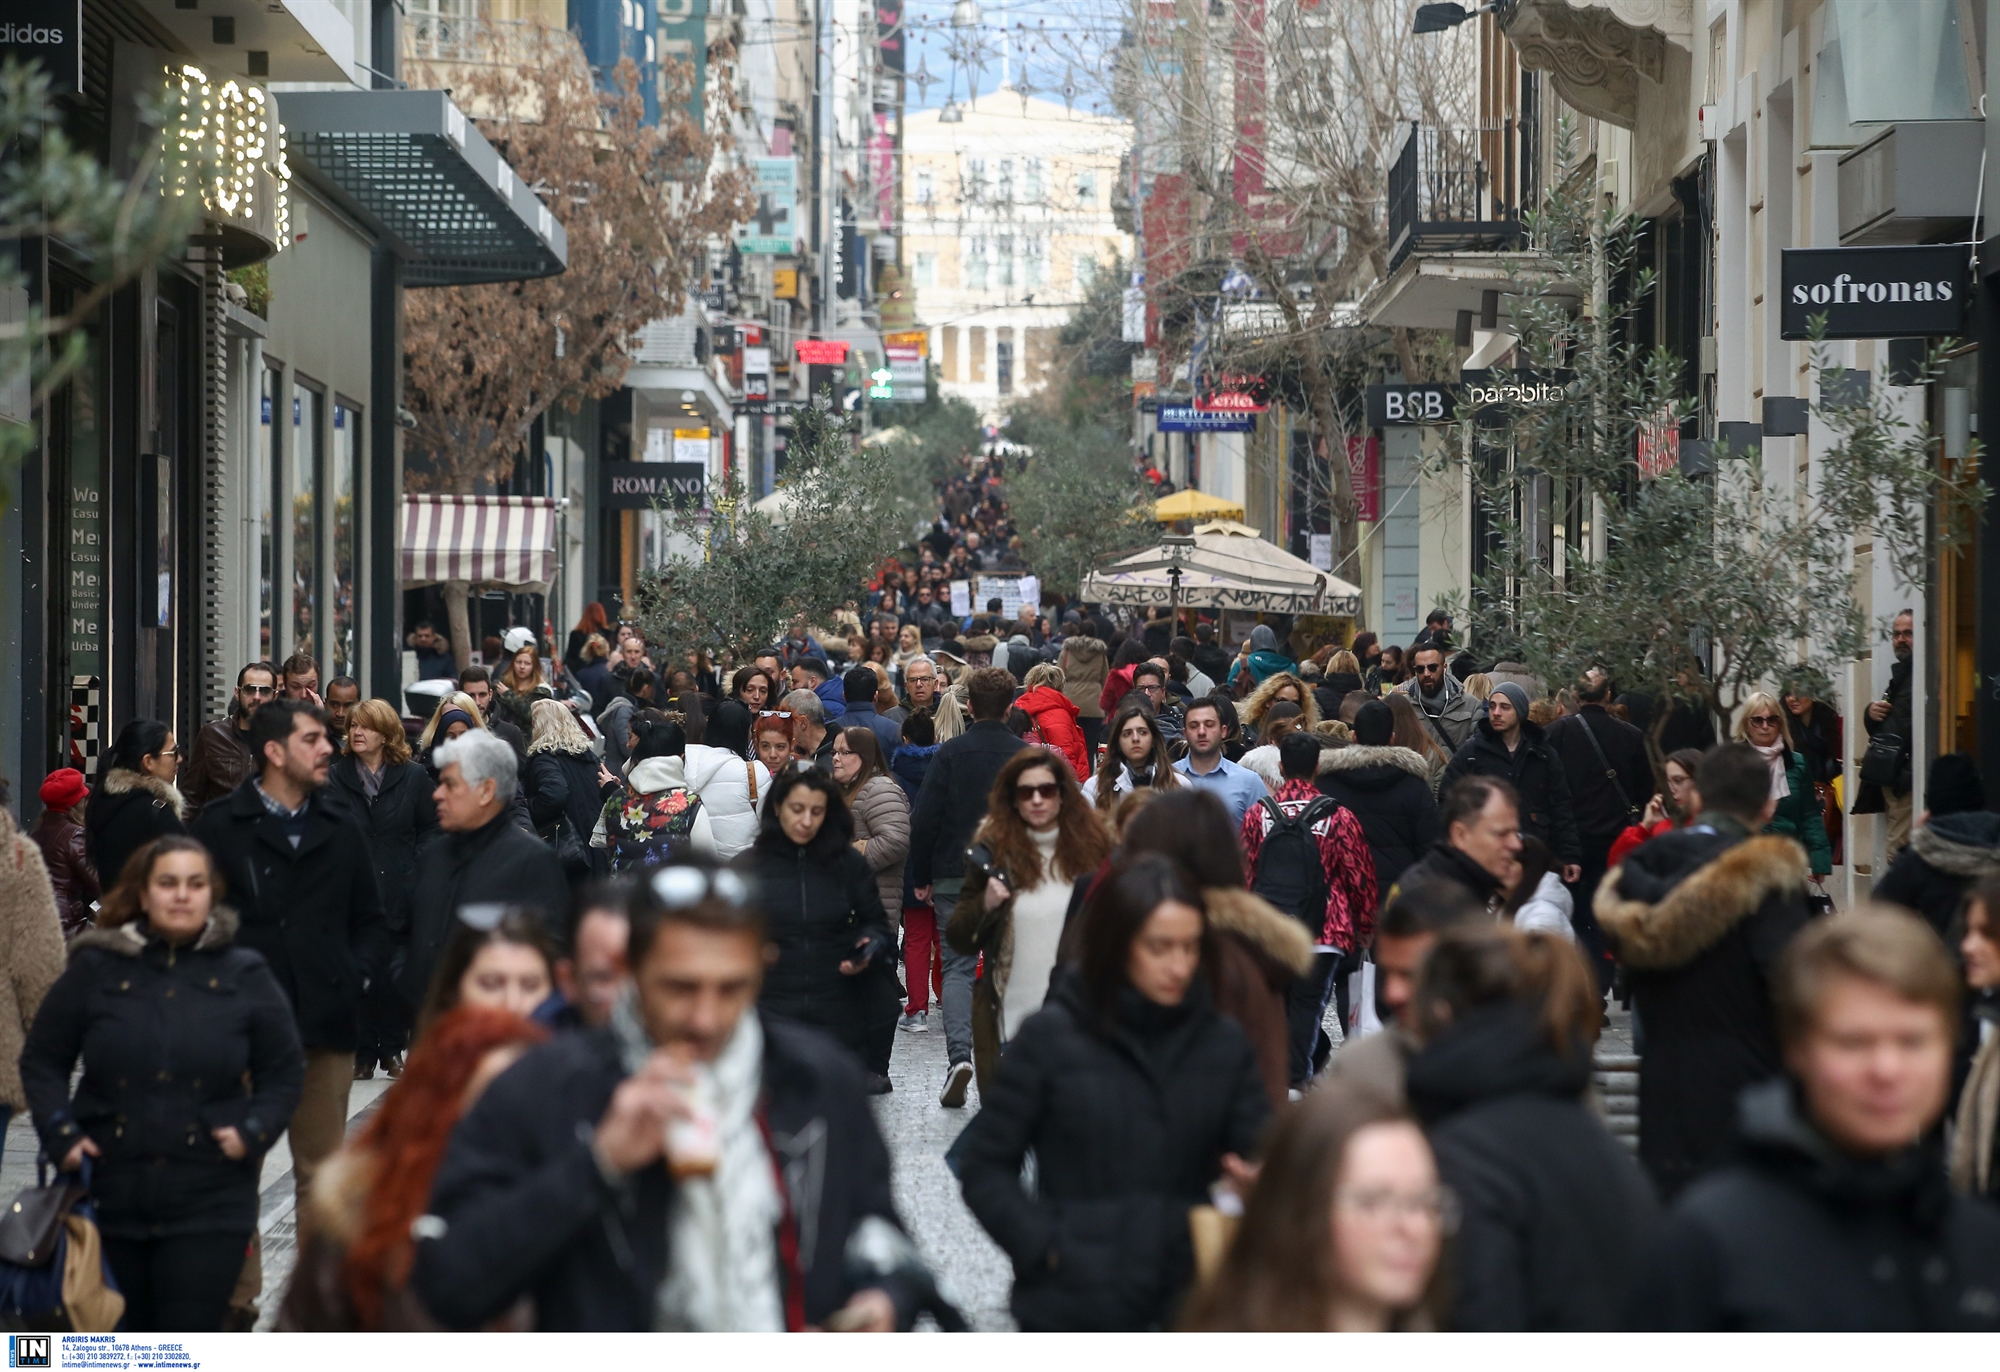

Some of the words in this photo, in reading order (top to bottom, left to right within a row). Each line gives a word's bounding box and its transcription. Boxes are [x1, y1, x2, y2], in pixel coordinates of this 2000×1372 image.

[1792, 273, 1953, 305] sofronas
[1386, 390, 1444, 420] BSB
[612, 476, 702, 495] ROMANO
[72, 528, 100, 546] Me
[72, 570, 100, 587] Me
